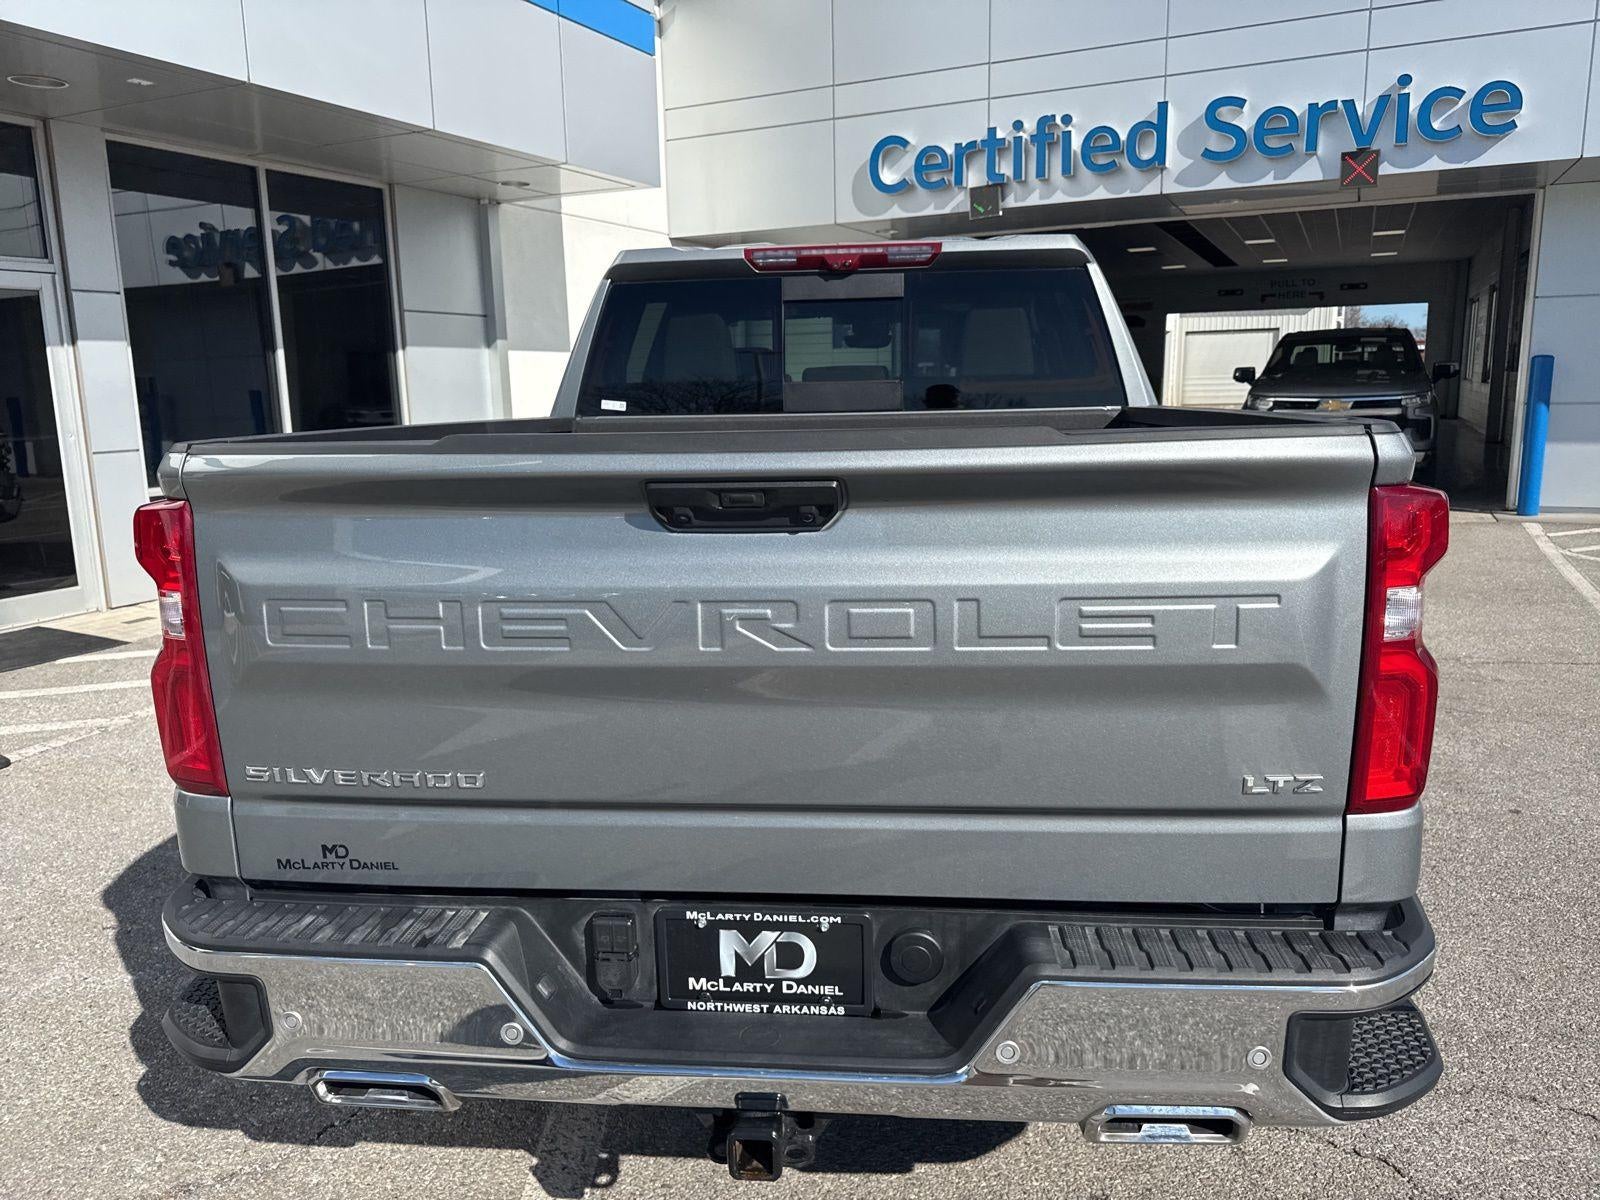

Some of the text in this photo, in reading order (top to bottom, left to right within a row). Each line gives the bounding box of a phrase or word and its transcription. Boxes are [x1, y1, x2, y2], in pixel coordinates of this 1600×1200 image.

[869, 73, 1523, 194] Certified Service
[1301, 278, 1316, 287] TO
[1278, 290, 1306, 300] HERE
[262, 593, 1282, 654] CHEVROLET
[245, 764, 486, 789] SILVERADO
[1241, 773, 1324, 795] LTZ
[321, 844, 349, 859] MD
[349, 859, 399, 870] DANIEL
[719, 929, 817, 979] MD
[782, 981, 844, 996] DANIEL
[687, 1001, 845, 1016] NORTHWEST ARKANSAS
